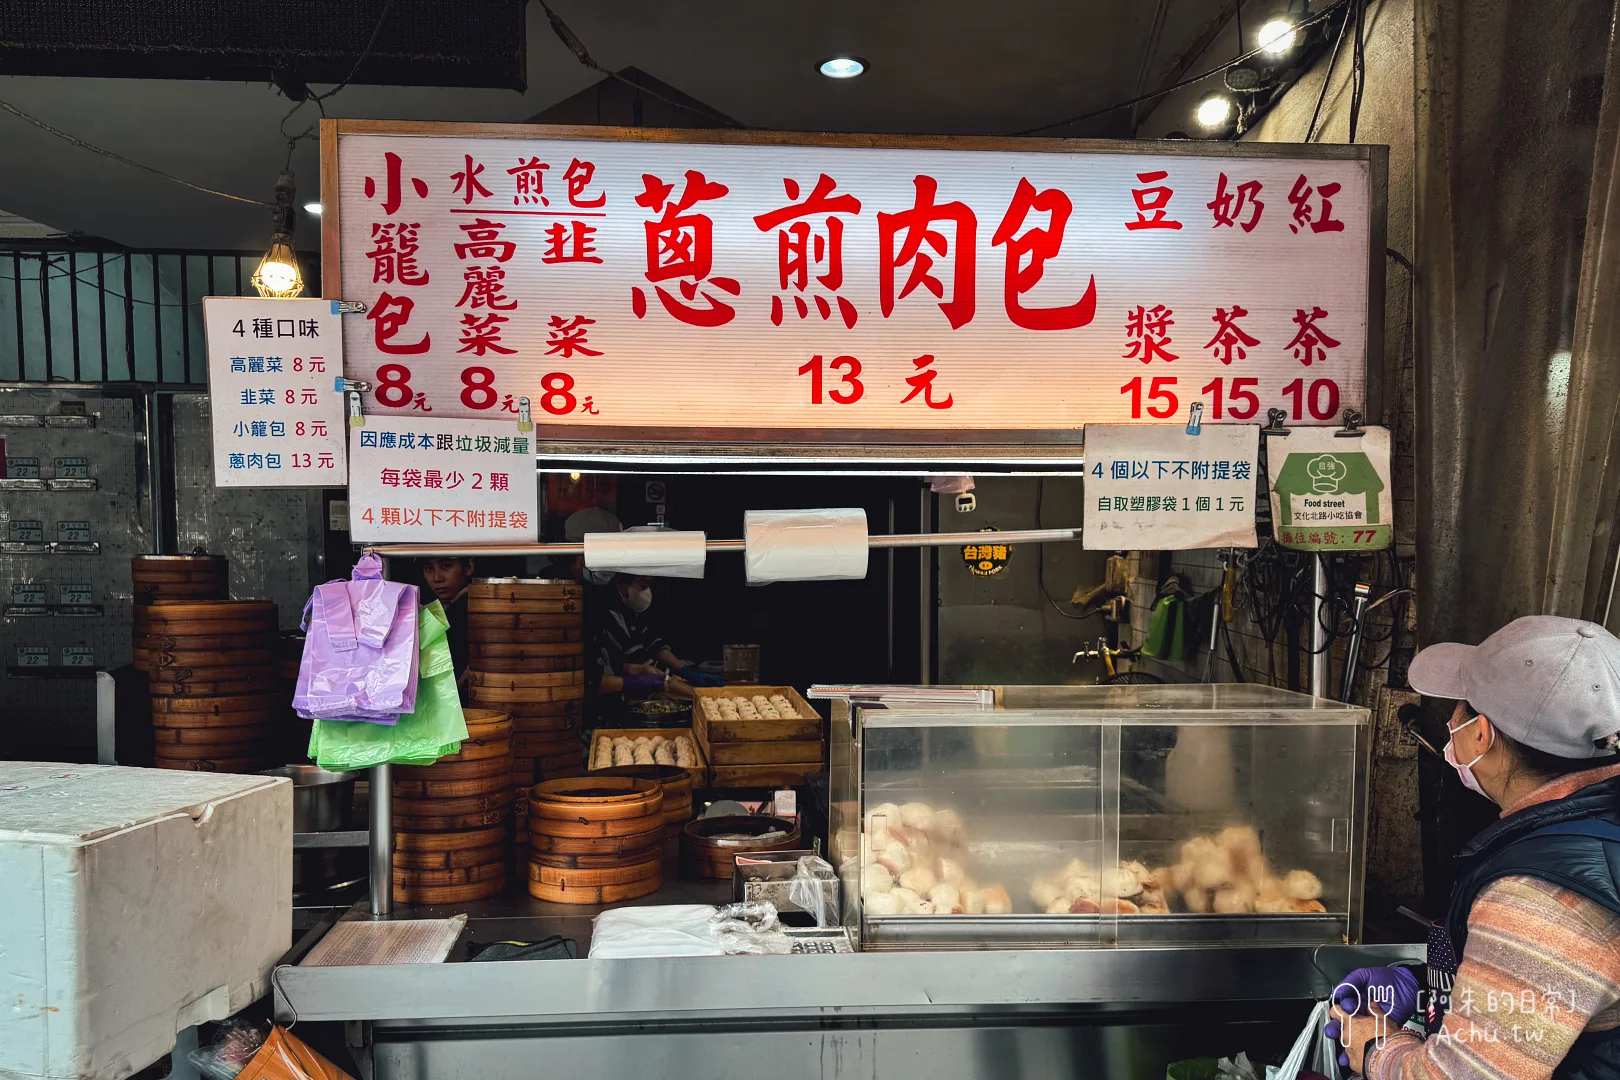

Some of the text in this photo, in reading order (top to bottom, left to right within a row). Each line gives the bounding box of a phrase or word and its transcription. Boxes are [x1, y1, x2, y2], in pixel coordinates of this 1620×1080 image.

[450, 154, 607, 209] 水煎包
[364, 152, 431, 355] 小籠包
[1202, 171, 1265, 365] 奶茶
[1283, 173, 1345, 366] 紅茶
[454, 218, 519, 357] 高麗菜
[229, 356, 284, 374] 高麗菜
[240, 388, 276, 405] 韭菜
[1120, 376, 1179, 420] 15
[1201, 377, 1260, 421] 15
[1282, 378, 1340, 421] 10
[232, 420, 286, 438] 小籠包
[360, 430, 530, 455] 因應成本跟垃圾減量
[16, 467, 28, 477] 22
[64, 467, 77, 477] 22
[1304, 499, 1345, 508] Food street
[1294, 510, 1363, 521] 文化北路小吃協會
[19, 531, 31, 540] 22
[67, 531, 79, 540] 22
[1353, 529, 1377, 544] 77
[23, 593, 35, 603] 22
[69, 593, 82, 603] 22
[26, 655, 39, 665] 22
[71, 655, 84, 665] 22
